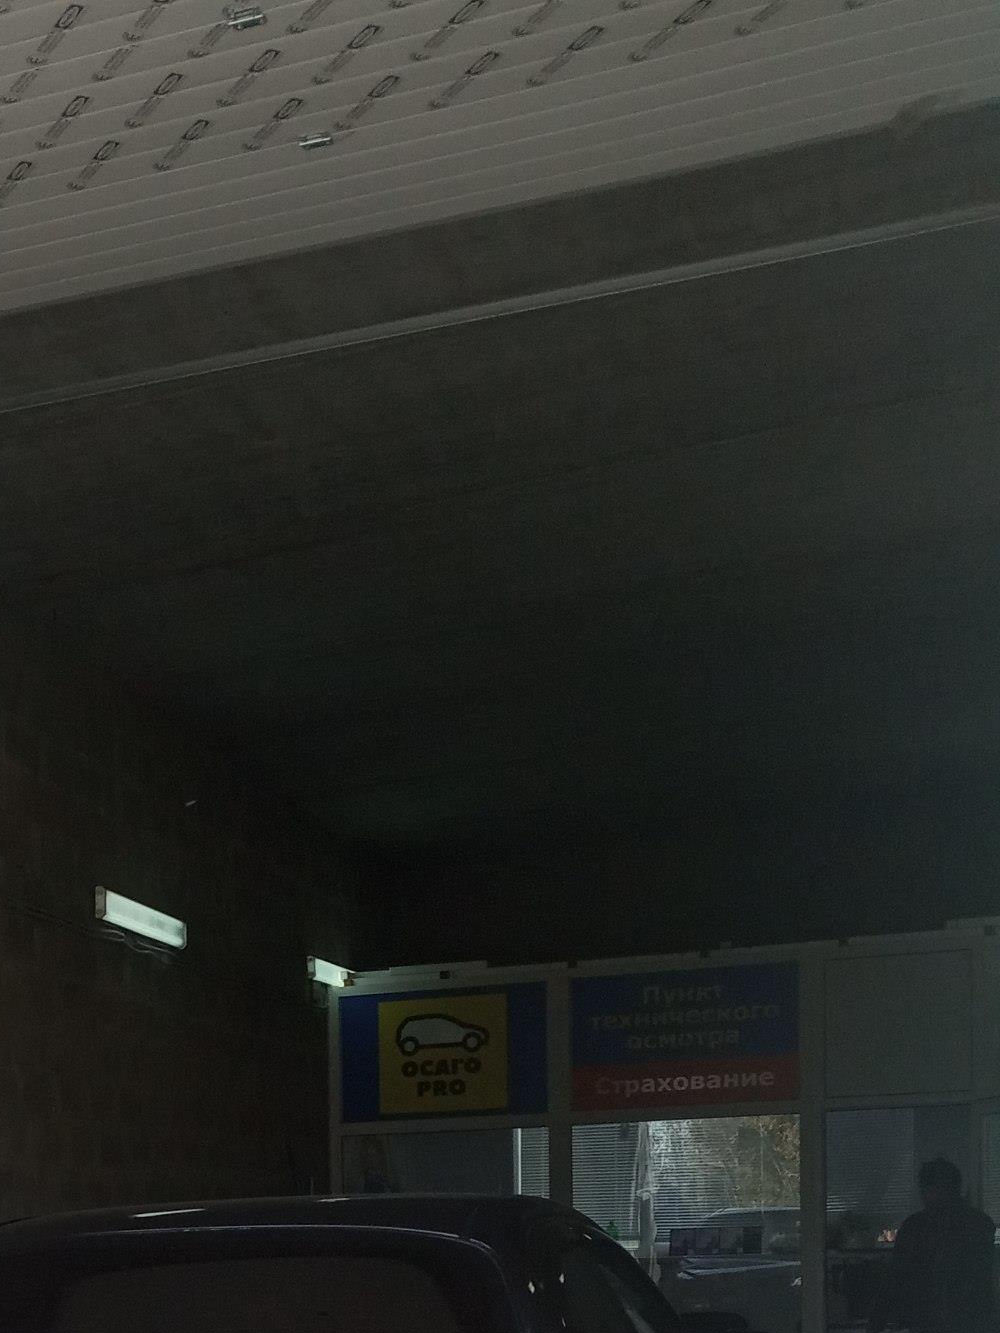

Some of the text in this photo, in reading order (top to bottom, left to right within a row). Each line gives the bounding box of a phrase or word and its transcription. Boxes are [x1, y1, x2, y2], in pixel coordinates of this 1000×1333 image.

[401, 1056, 481, 1078] ОСАГО
[417, 1078, 465, 1097] PRO
[597, 1070, 775, 1098] Страхование
